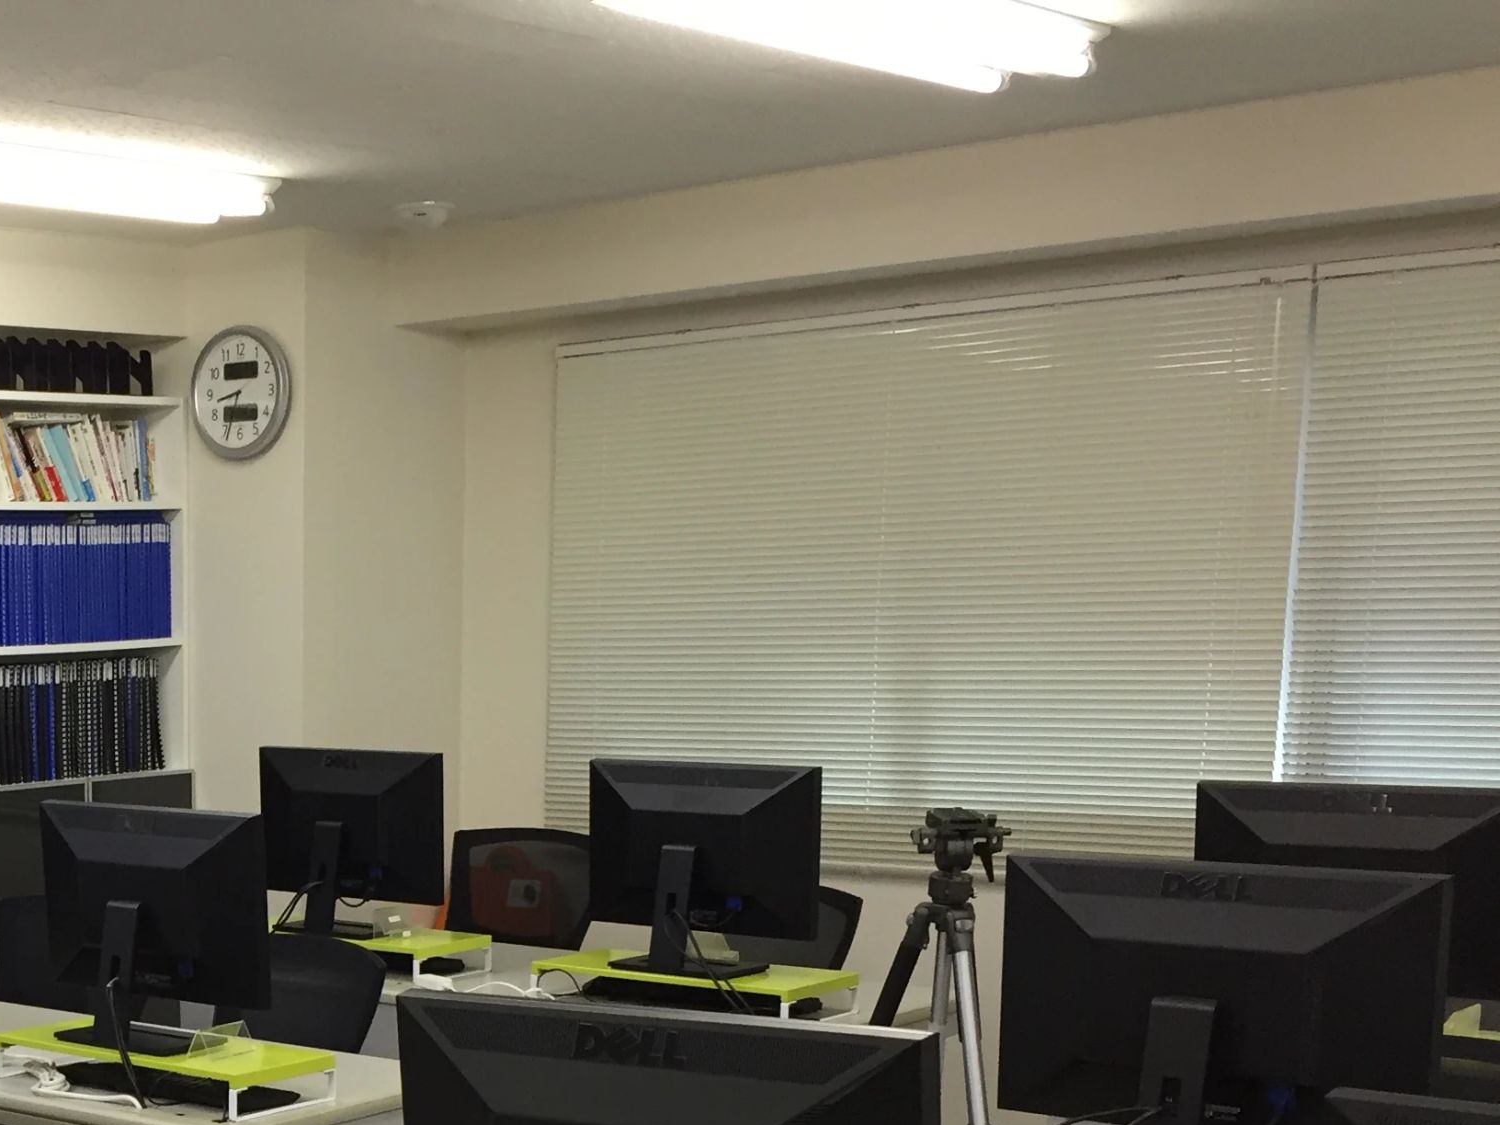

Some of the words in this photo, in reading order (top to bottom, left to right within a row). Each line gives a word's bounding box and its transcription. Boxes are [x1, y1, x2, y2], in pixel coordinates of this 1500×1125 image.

[221, 348, 230, 362] 11
[236, 343, 245, 357] 12
[210, 367, 220, 381] 10
[264, 361, 271, 374] 2
[206, 388, 213, 402] 9
[268, 383, 275, 397] 3
[211, 408, 219, 421] 8
[262, 404, 270, 417] 4
[236, 427, 244, 440] 6
[252, 423, 259, 435] 5
[1159, 871, 1255, 903] DELL
[570, 1020, 688, 1068] DELL
